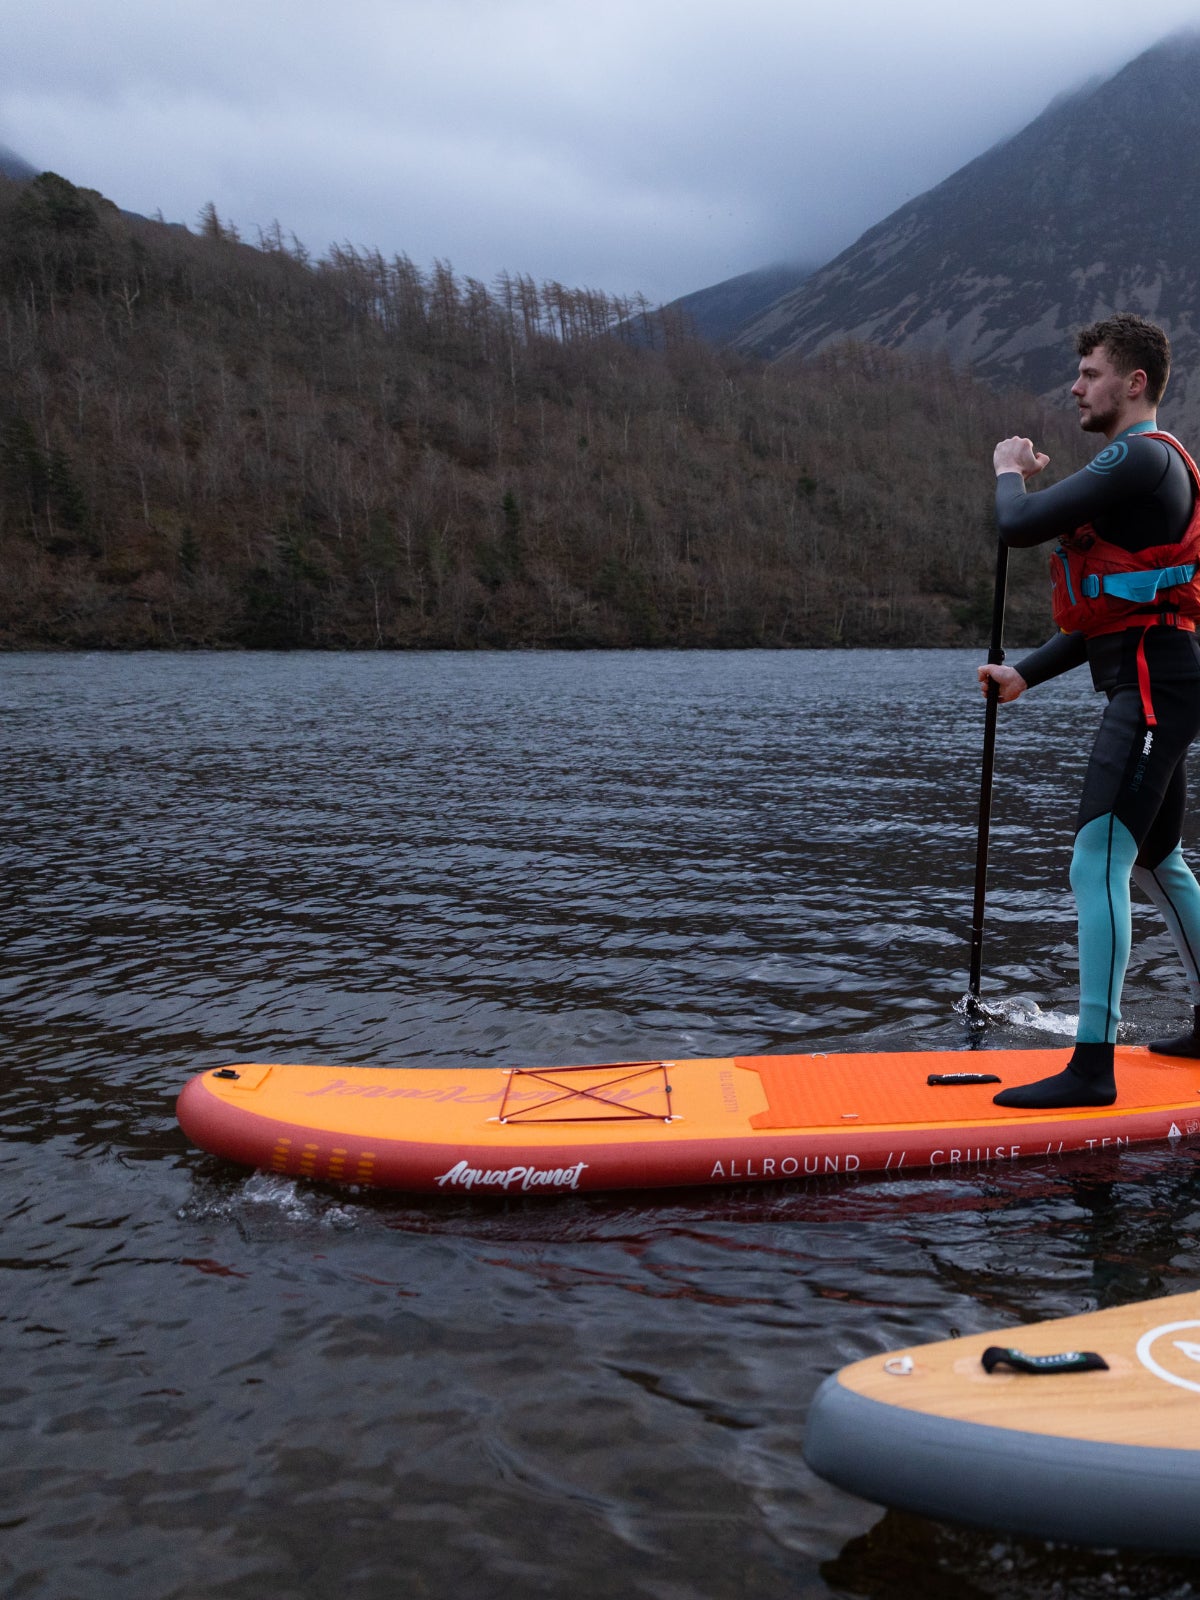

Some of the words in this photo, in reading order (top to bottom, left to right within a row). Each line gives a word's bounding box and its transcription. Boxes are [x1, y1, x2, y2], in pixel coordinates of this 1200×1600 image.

[1142, 730, 1154, 756] alpkit
[434, 1160, 589, 1191] AquaPlanet
[711, 1154, 860, 1177] ALLROUND
[886, 1151, 906, 1169] //
